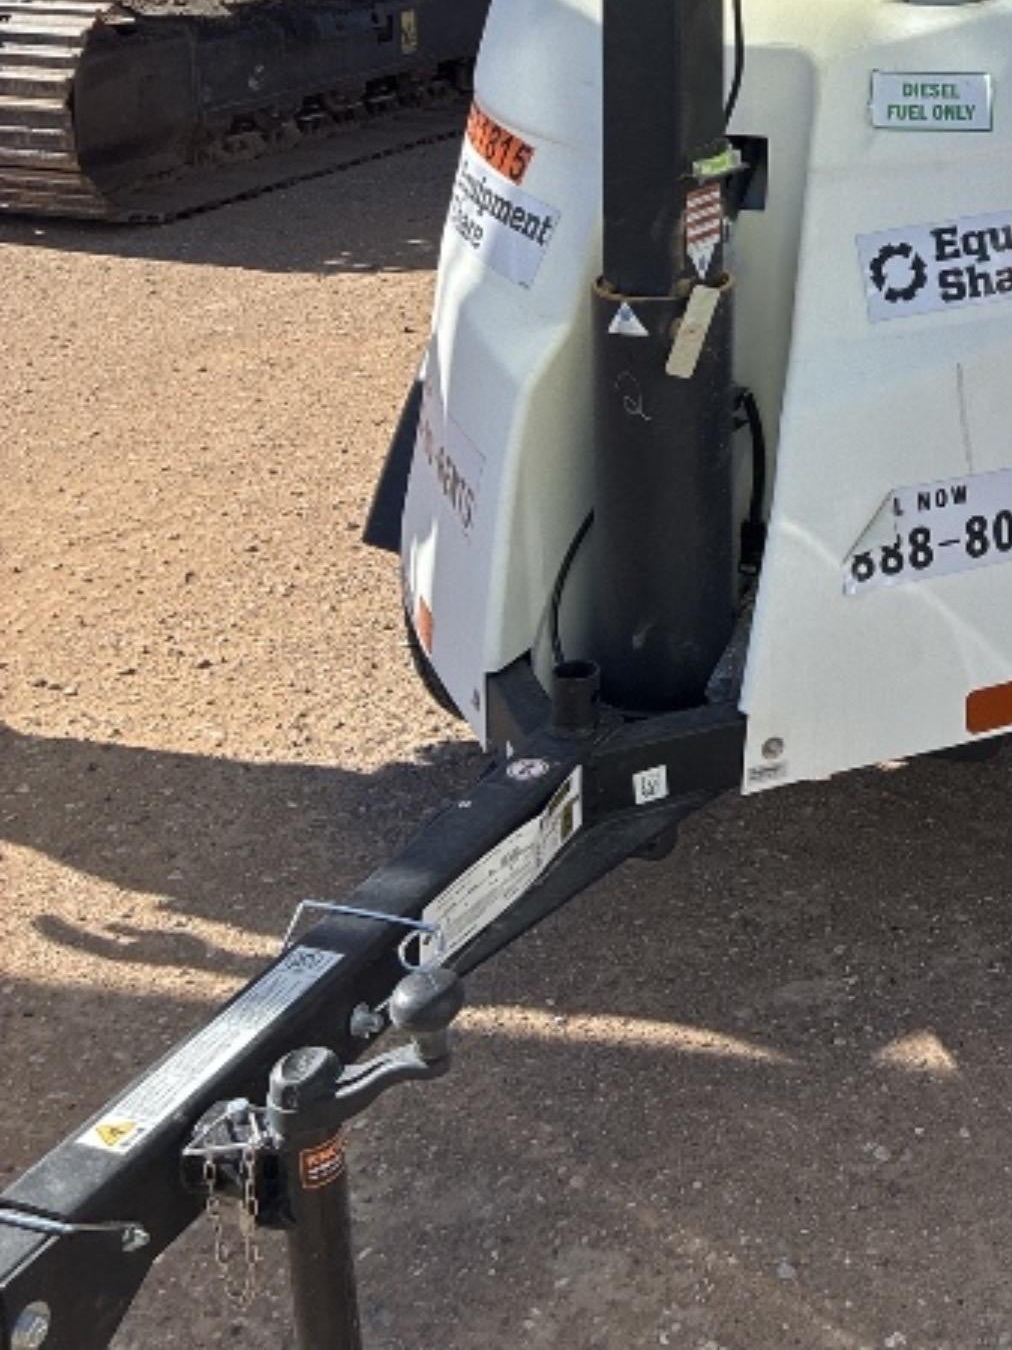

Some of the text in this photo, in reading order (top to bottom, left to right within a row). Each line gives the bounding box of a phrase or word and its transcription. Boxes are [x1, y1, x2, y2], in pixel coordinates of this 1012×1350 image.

[902, 83, 960, 100] DIESEL
[887, 103, 976, 121] FUEL ONLY
[916, 485, 968, 512] NOW
